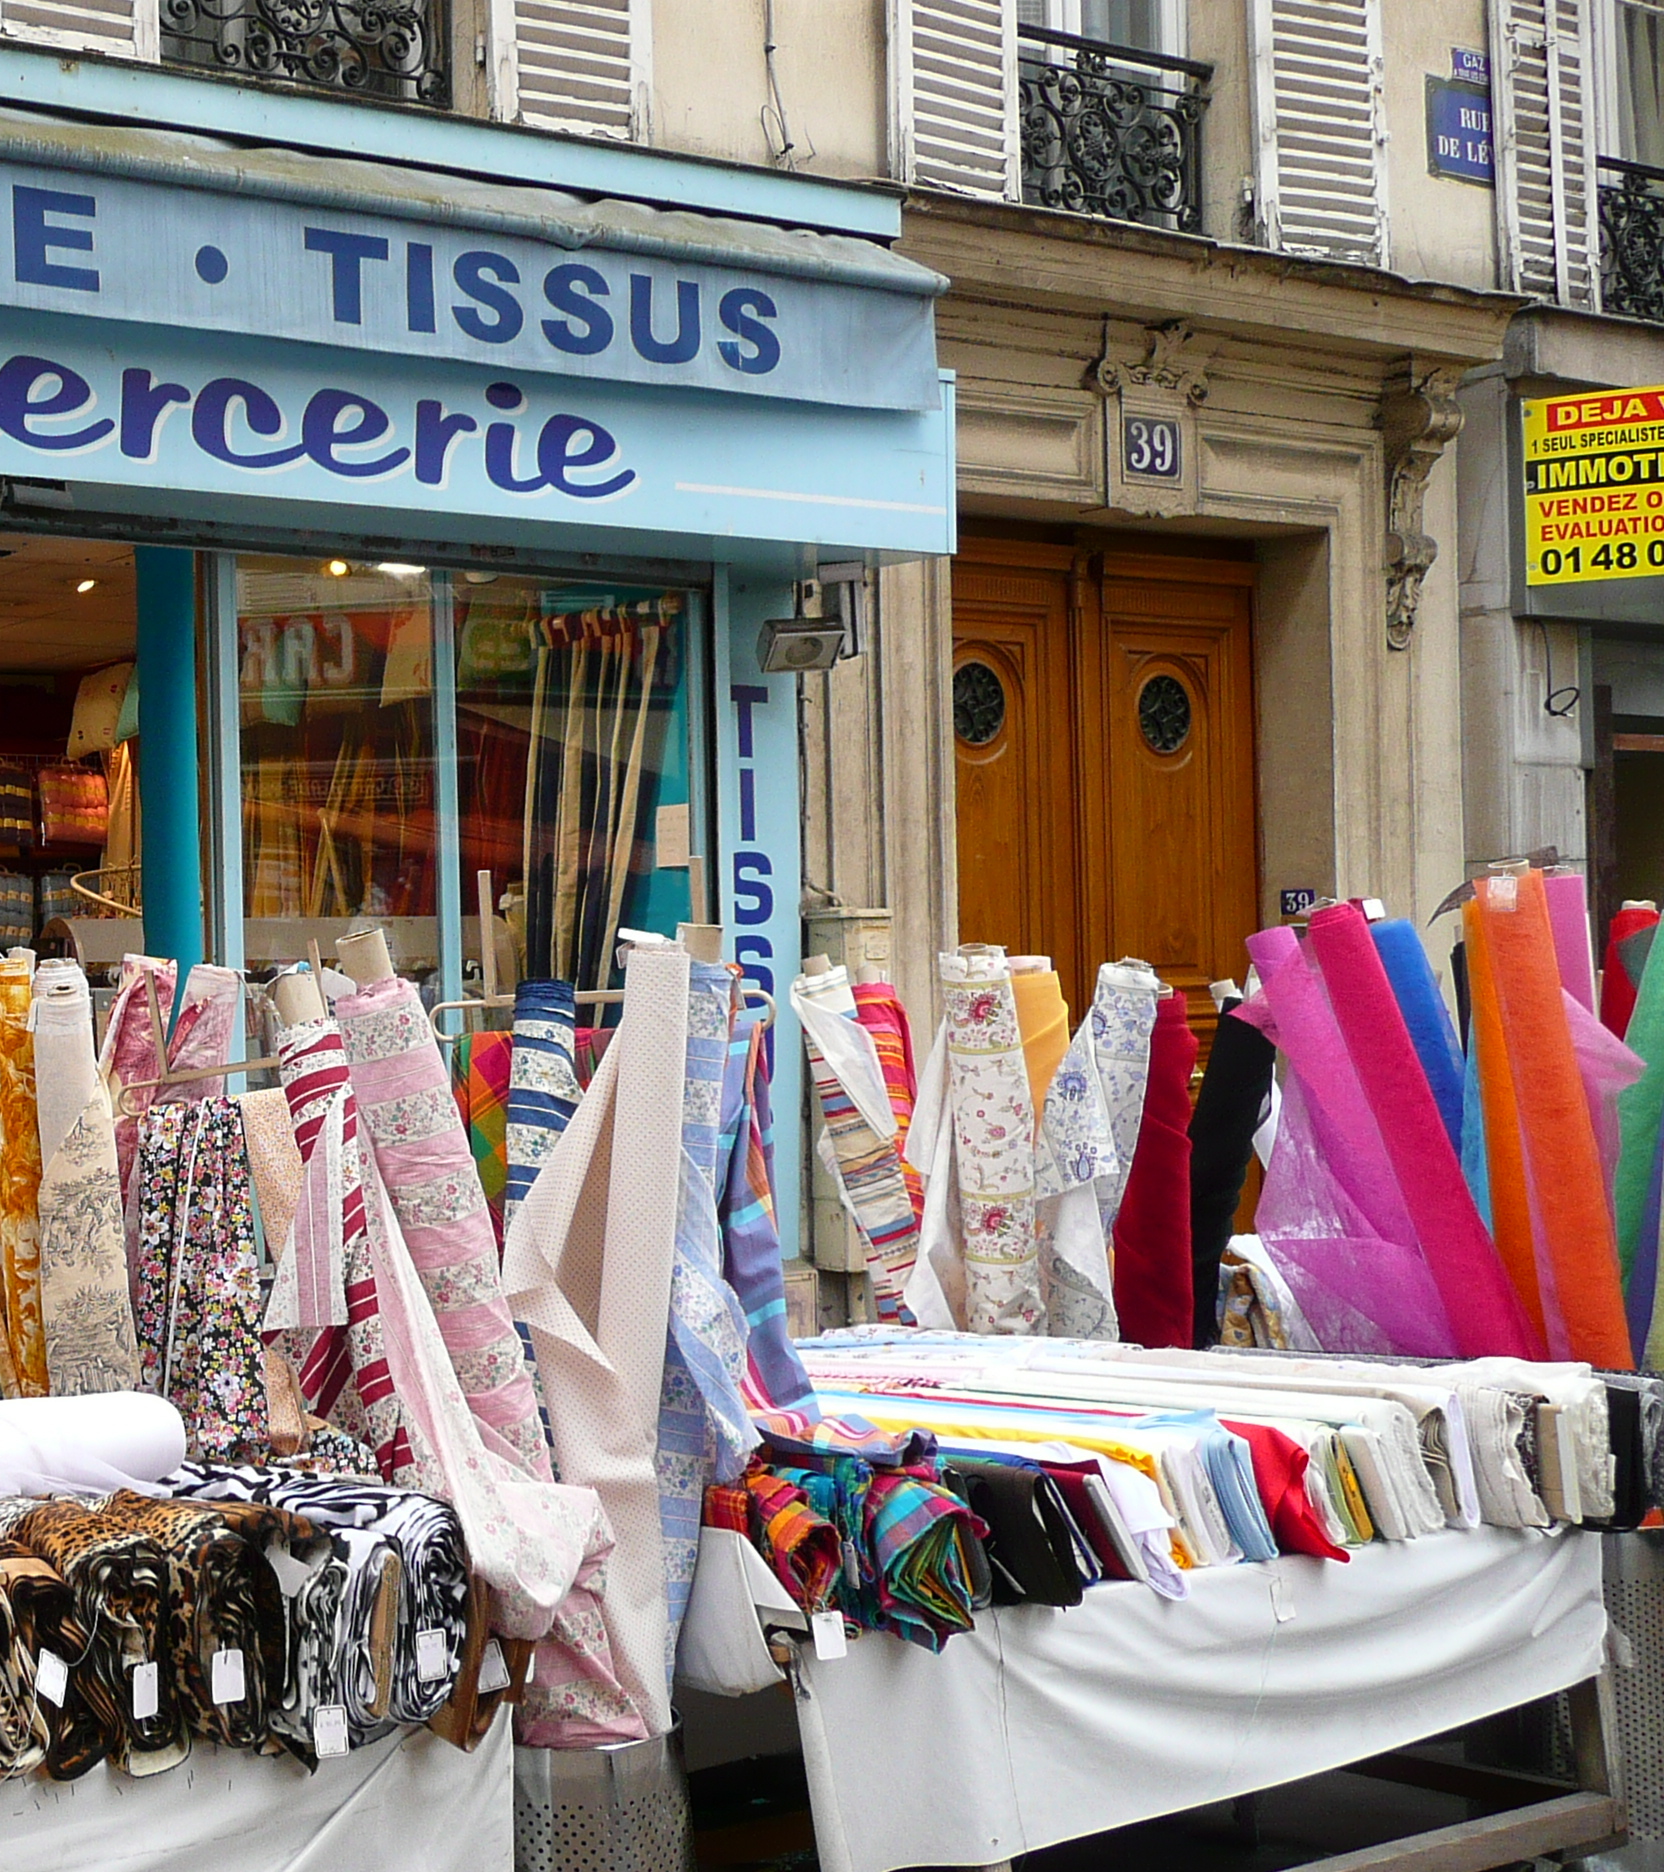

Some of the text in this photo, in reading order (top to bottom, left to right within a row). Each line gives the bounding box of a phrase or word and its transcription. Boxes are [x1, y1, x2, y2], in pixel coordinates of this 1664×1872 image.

[1463, 54, 1485, 71] GAZ
[1460, 107, 1490, 133] RUE
[1438, 135, 1493, 165] DE LÉ
[303, 226, 781, 375] TISSUS
[1557, 398, 1648, 426] DEJA
[1131, 422, 1172, 471] 39
[1542, 437, 1576, 453] SEUL
[1580, 425, 1664, 449] SPECIALISTE
[1539, 492, 1638, 518] VENDEZ
[1541, 546, 1581, 576] 01
[1590, 541, 1637, 571] 48
[730, 684, 776, 1124] TISS
[1286, 892, 1310, 912] 39
